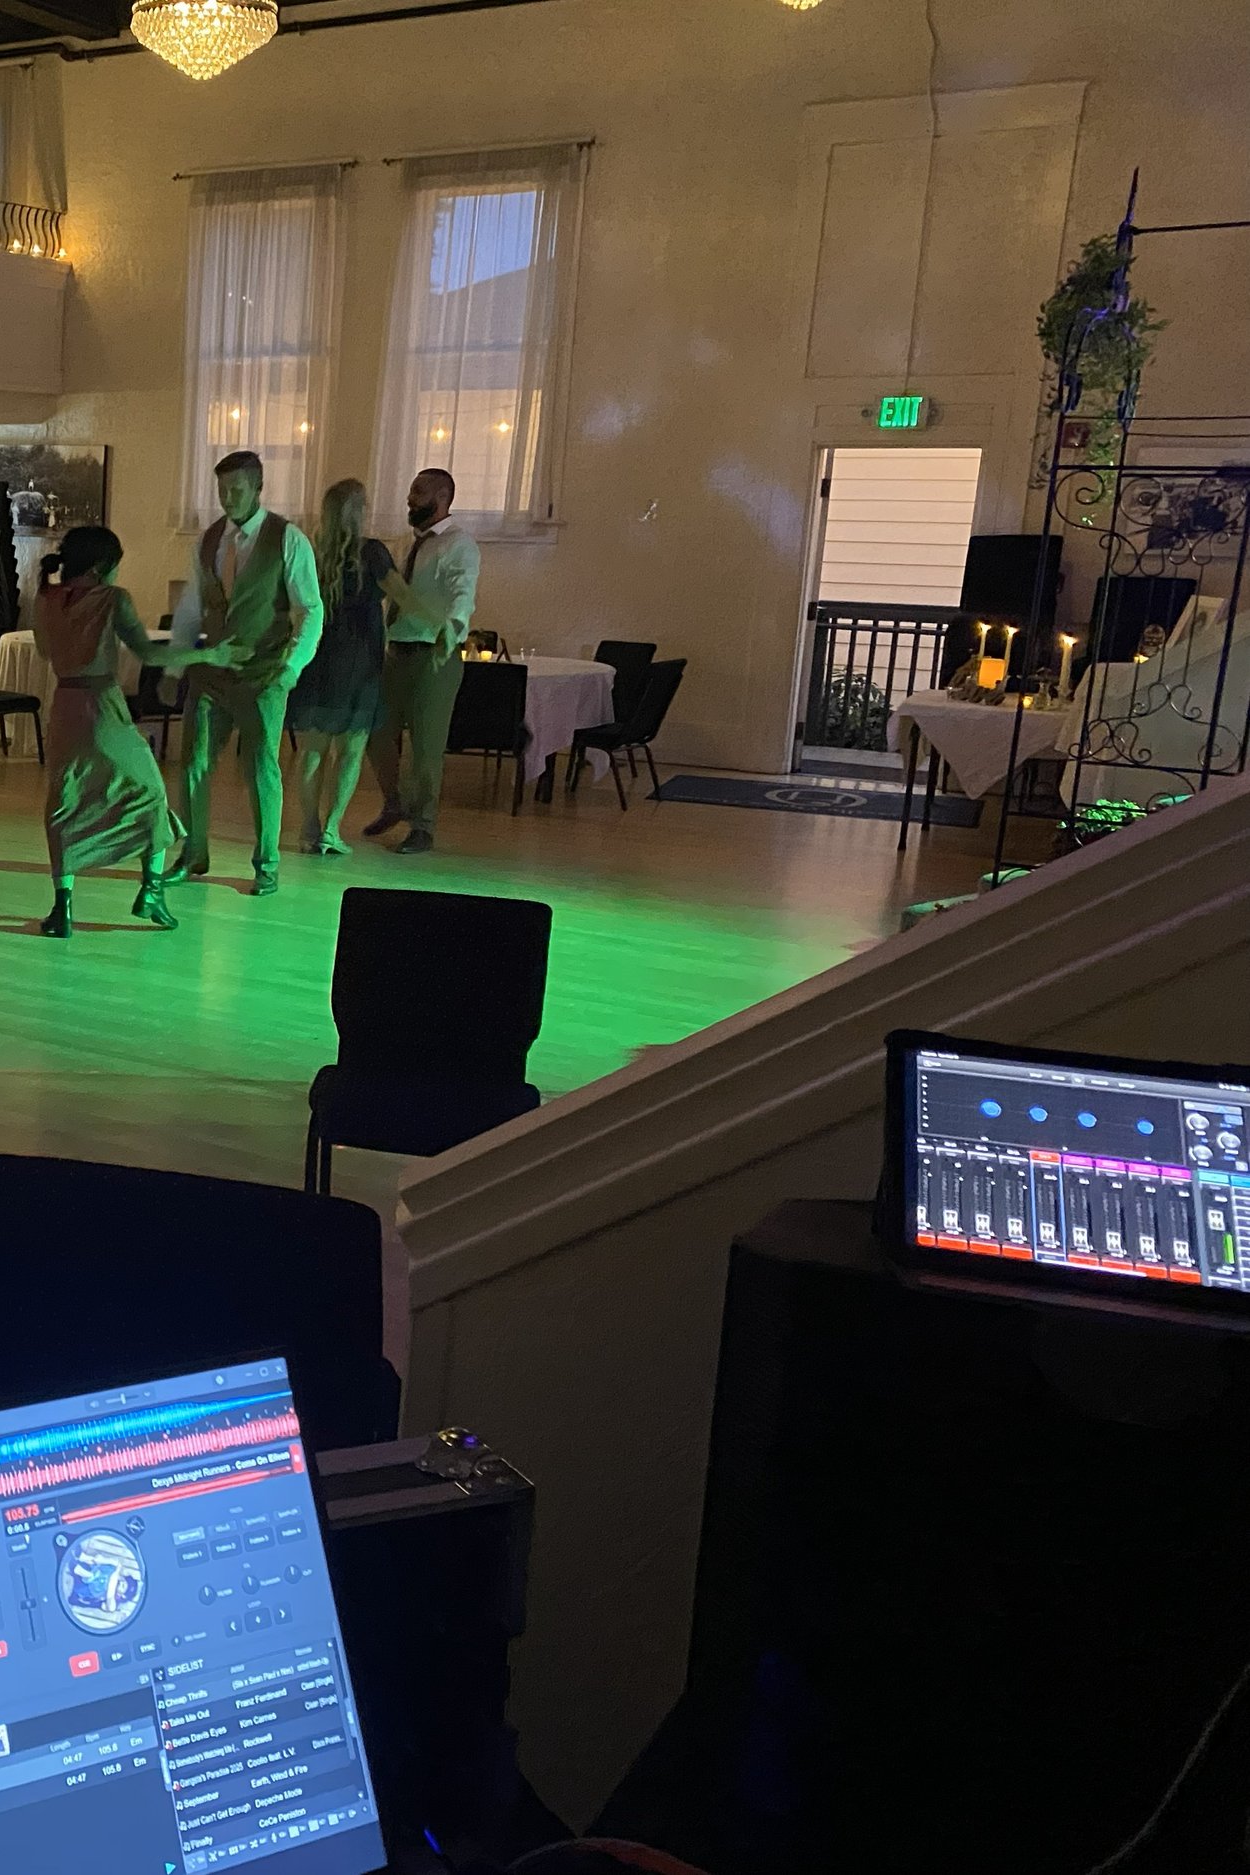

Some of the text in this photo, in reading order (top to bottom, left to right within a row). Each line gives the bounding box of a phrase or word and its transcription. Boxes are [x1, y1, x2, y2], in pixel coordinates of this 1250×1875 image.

[879, 397, 924, 427] EXIT
[203, 1464, 231, 1477] Runners
[256, 1456, 268, 1466] On
[167, 1659, 204, 1677] SIDELIST
[235, 1688, 288, 1709] Franz Ferdinand
[197, 1709, 211, 1720] Out
[239, 1717, 253, 1729] Kim
[210, 1726, 227, 1738] Eyes
[130, 1737, 143, 1747] Em
[134, 1757, 147, 1768] Em
[270, 1770, 288, 1782] Wind
[294, 1765, 308, 1775] Fire
[183, 1791, 219, 1808] September
[190, 1835, 213, 1850] Finally
